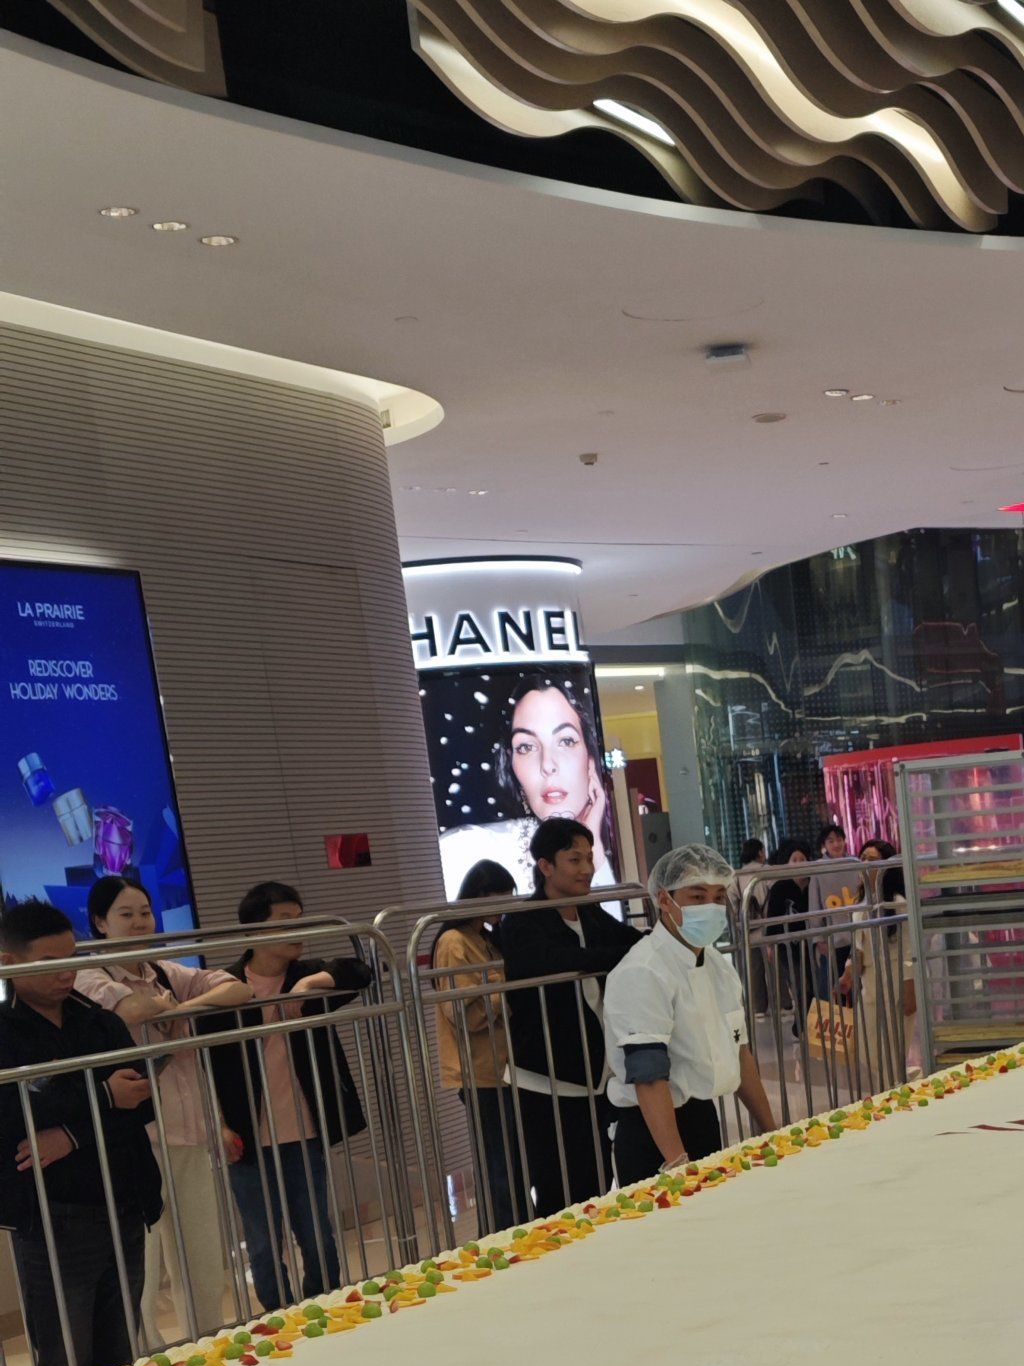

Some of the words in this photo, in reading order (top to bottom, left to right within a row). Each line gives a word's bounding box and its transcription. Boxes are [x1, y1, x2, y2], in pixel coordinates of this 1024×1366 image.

[17, 601, 34, 617] LA
[35, 602, 85, 620] PRAIRIE
[33, 620, 75, 628] SWITZERLAND
[411, 609, 589, 657] HANEL
[28, 659, 94, 678] REDISCOVER
[9, 682, 58, 700] HOLIDAY
[61, 683, 118, 701] WONDERS
